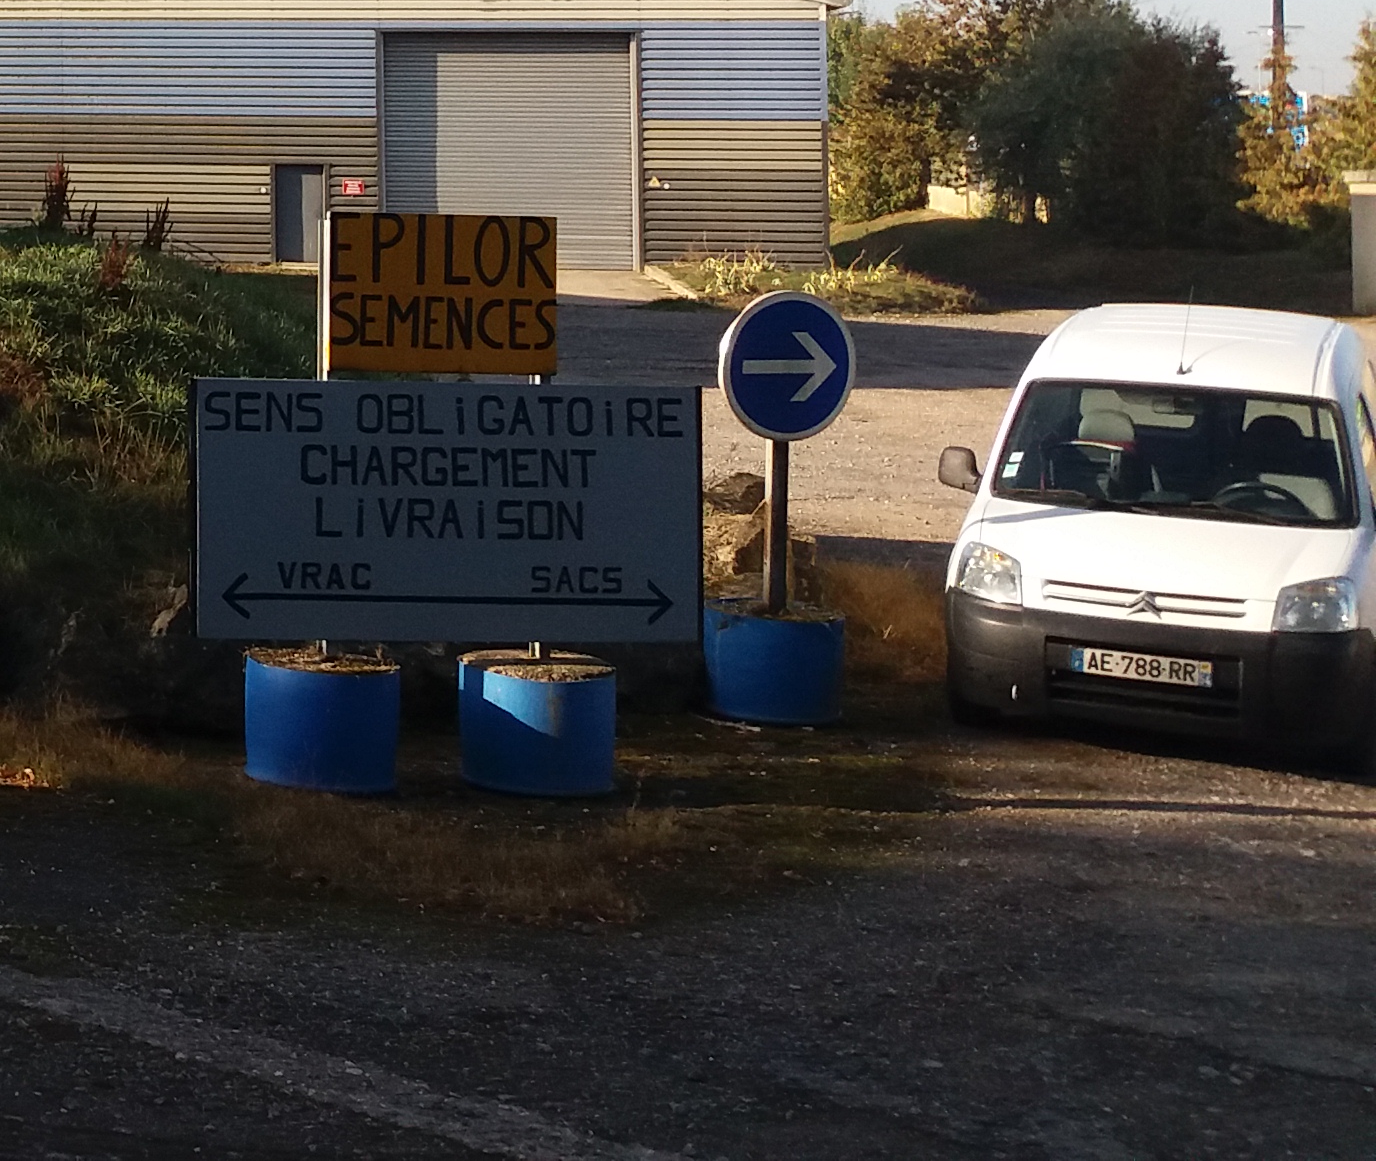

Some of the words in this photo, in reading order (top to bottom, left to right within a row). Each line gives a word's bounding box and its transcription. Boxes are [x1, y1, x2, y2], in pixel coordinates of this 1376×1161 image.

[331, 213, 554, 288] EPILOR
[330, 292, 557, 351] SEMENCES
[204, 391, 323, 433] SENS
[300, 444, 597, 488] CHARGEMENT
[277, 562, 372, 590] VRAC
[531, 566, 623, 594] SACS
